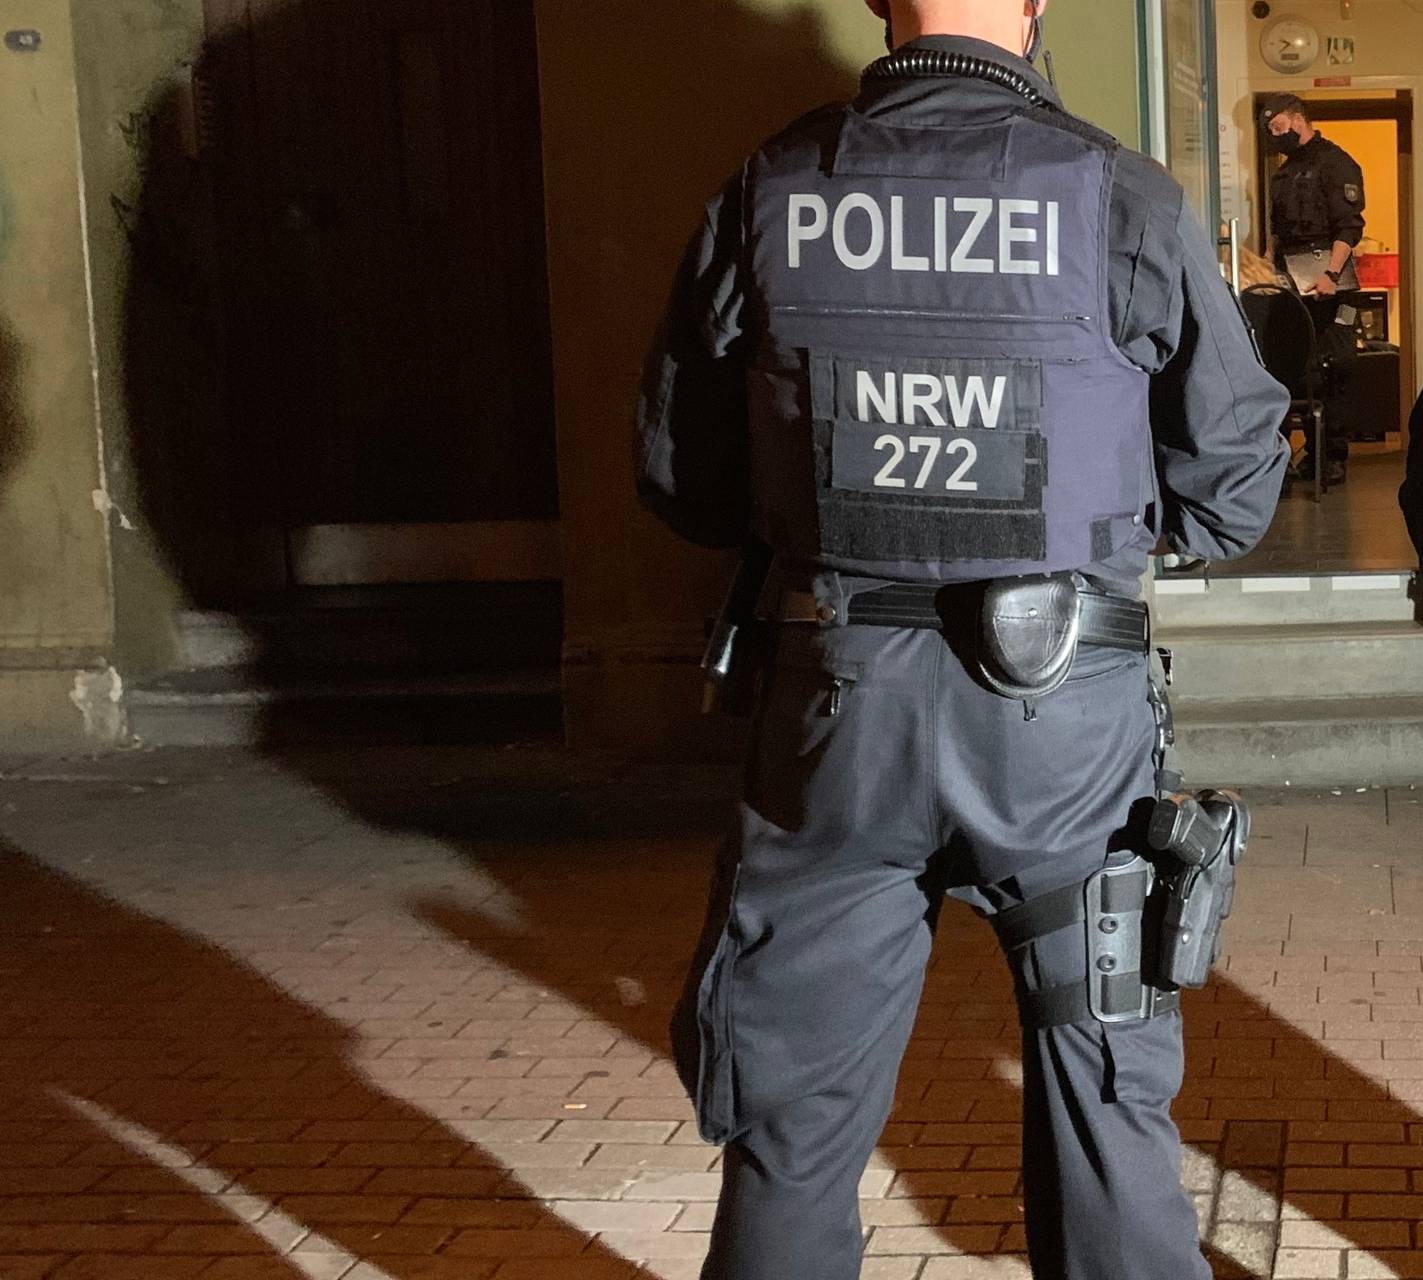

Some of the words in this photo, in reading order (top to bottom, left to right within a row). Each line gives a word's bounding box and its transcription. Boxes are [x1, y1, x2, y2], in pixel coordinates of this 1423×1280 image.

[787, 192, 1060, 276] POLIZEI
[856, 370, 1007, 428] NRW
[873, 434, 978, 491] 272
